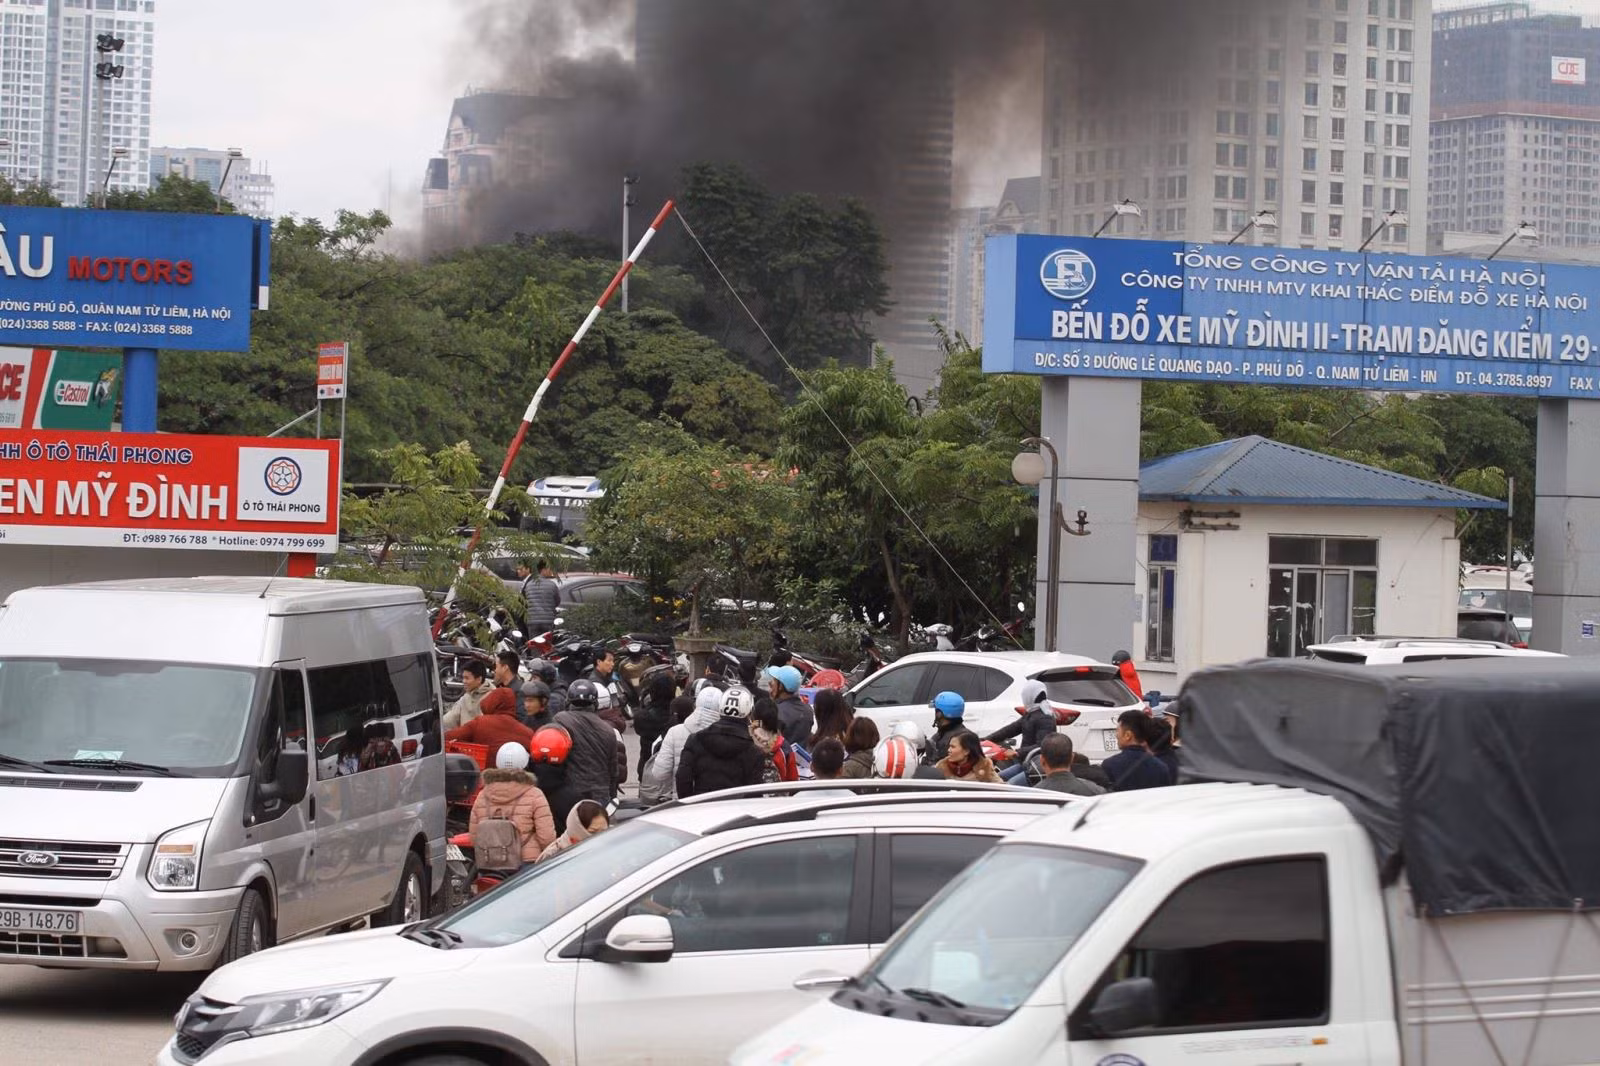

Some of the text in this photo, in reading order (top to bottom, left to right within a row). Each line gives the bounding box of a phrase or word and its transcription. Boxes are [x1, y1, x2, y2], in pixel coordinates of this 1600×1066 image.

[68, 256, 193, 286] MOTORS
[1172, 245, 1546, 290] TỔNG CÔNG TY VẬN TẢI HÀ NỘI
[1121, 269, 1587, 314] CÔNG TY TNHH MTV KHAI THÁC ĐIỂM ĐỖ XE HÀ NỘI
[33, 300, 56, 312] PHÚ
[116, 304, 141, 316] NAM
[145, 304, 160, 316] TỪ
[163, 305, 190, 319] LIÊM,
[193, 306, 208, 318] HÀ
[211, 307, 231, 321] NỘI
[52, 321, 76, 331] 5888
[86, 322, 112, 332] FAX:
[169, 325, 193, 335] 5888
[1052, 299, 1103, 340] BẾN
[1109, 298, 1150, 342] ĐỖ
[1156, 314, 1192, 344] XE
[1198, 309, 1240, 346] MỸ
[1246, 310, 1308, 349] ĐÌNH
[1417, 319, 1488, 358] ĐĂNG
[1493, 316, 1552, 360] KIỂM
[1, 362, 25, 401] CE
[1035, 352, 1061, 367] Đ/C:
[1062, 348, 1080, 368] SỐ
[1083, 356, 1091, 368] 3
[1093, 352, 1137, 371] ĐƯỜNG
[1141, 354, 1155, 371] LÊ
[1159, 359, 1202, 374] QUANG
[1206, 361, 1232, 378] ĐẠO
[1286, 360, 1304, 377] ĐÔ
[1363, 363, 1380, 380] TỪ
[1383, 364, 1409, 382] LIÊM
[1420, 370, 1437, 383] HN
[1456, 371, 1477, 385] ĐT:
[1478, 372, 1552, 388] 04.3785.8997
[1570, 377, 1593, 391] FAX
[63, 384, 91, 402] Castrol
[0, 438, 193, 465] HH Ô TÔ THÁI PHONG
[0, 471, 228, 520] EN MỸ ĐÌNH
[242, 500, 321, 513] Ô TÔ THÁI PHONG
[123, 533, 325, 548] ĐT: 0989 766 788 Hotline: 0974 799 699
[25, 853, 48, 865] Ford
